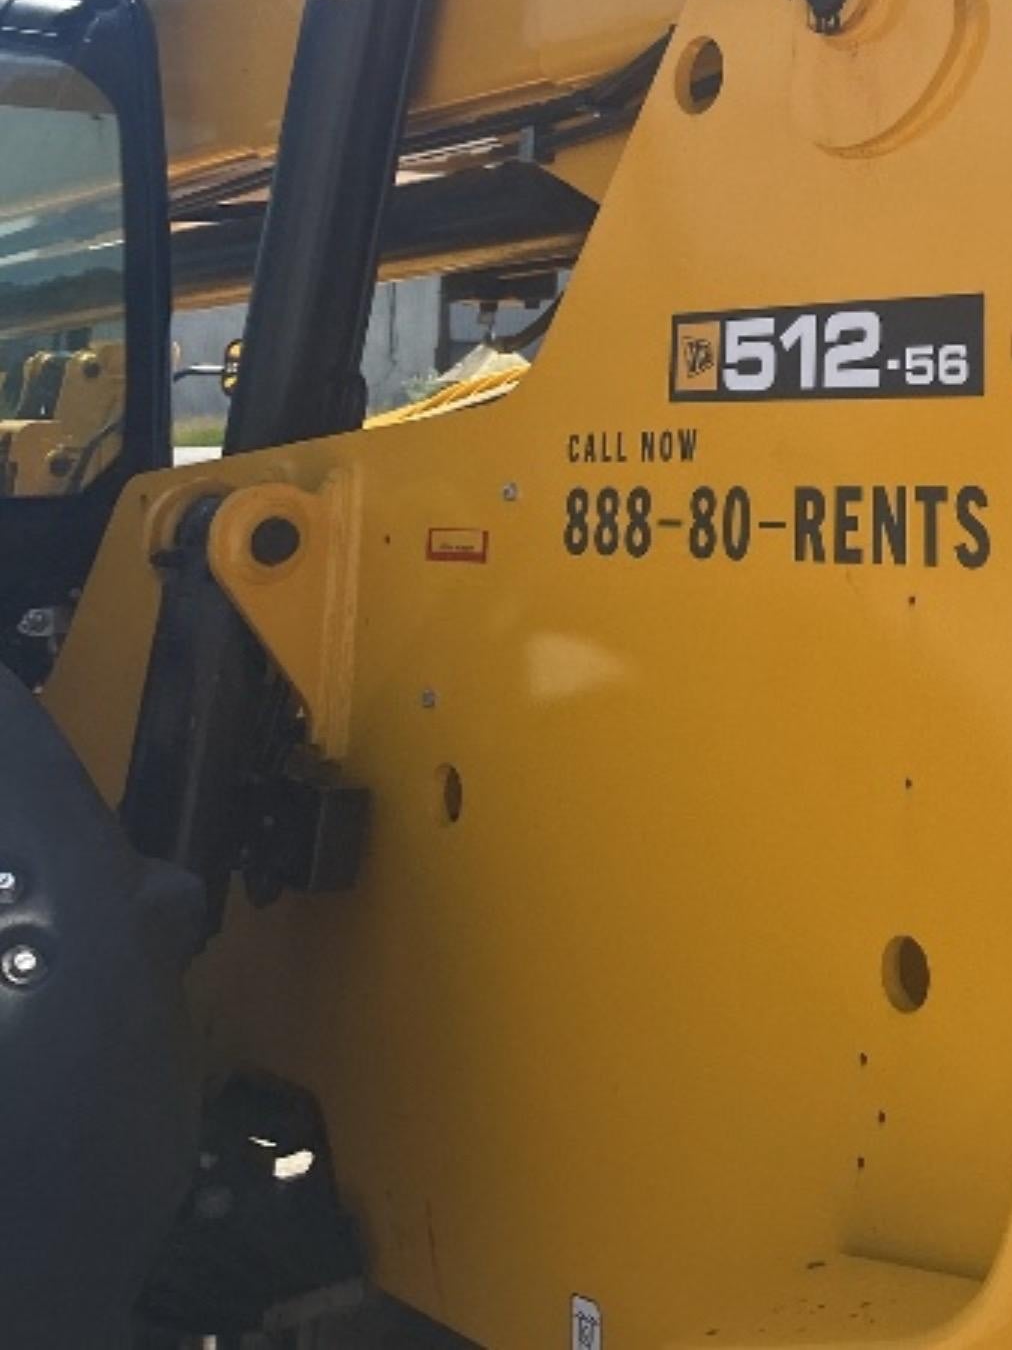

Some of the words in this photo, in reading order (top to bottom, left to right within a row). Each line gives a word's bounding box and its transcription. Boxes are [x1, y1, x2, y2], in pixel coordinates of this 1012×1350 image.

[567, 432, 628, 463] CALL
[640, 428, 698, 462] NOW
[563, 484, 992, 570] 888-80-RENTS
